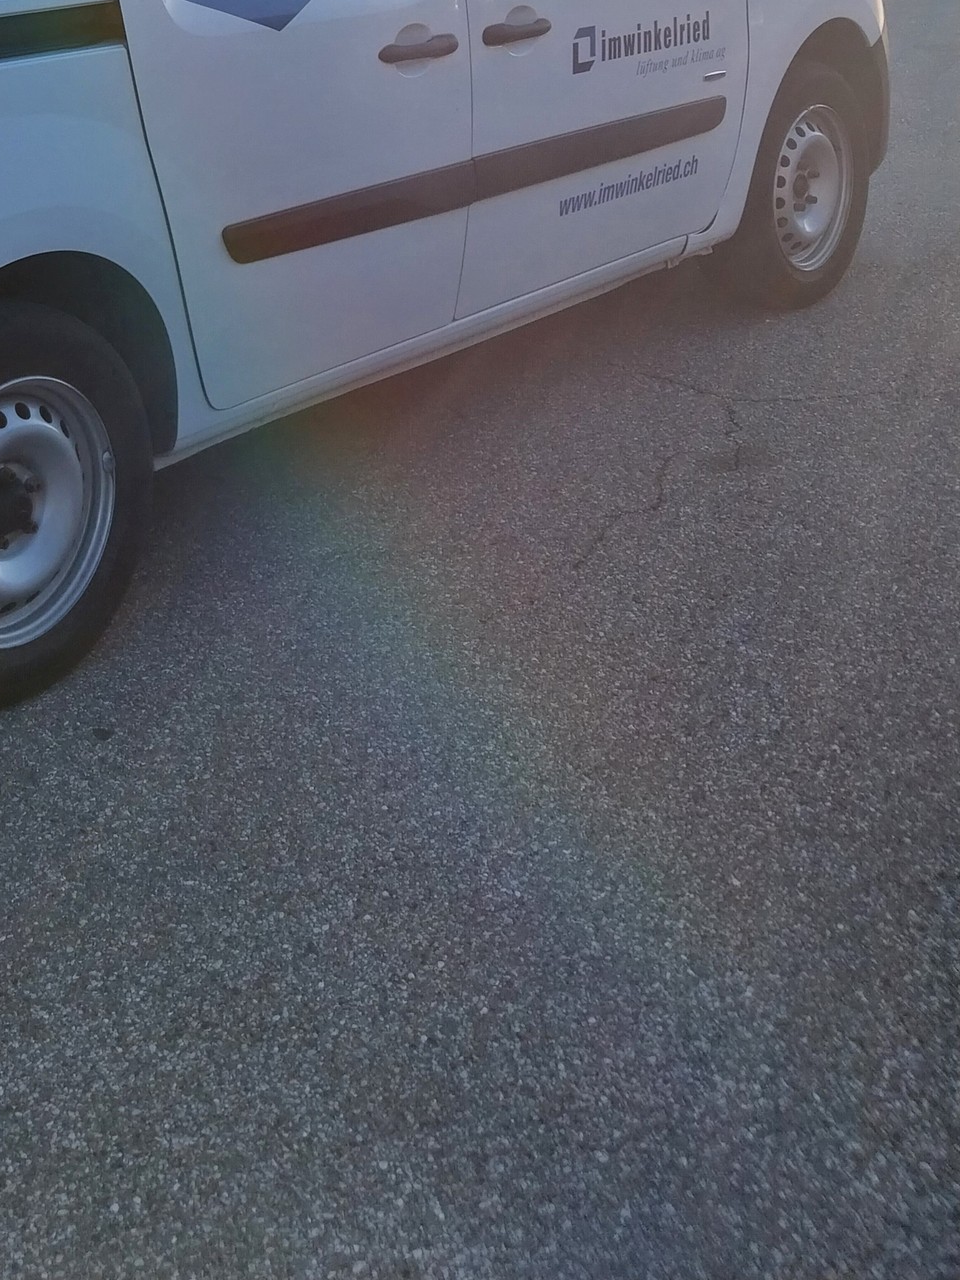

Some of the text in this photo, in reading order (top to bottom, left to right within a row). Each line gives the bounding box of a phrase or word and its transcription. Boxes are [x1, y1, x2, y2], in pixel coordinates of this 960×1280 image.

[601, 10, 710, 62] imwinkelried
[636, 46, 726, 78] lüftung und klima ag
[559, 155, 699, 217] www.imwinkelried.ch
